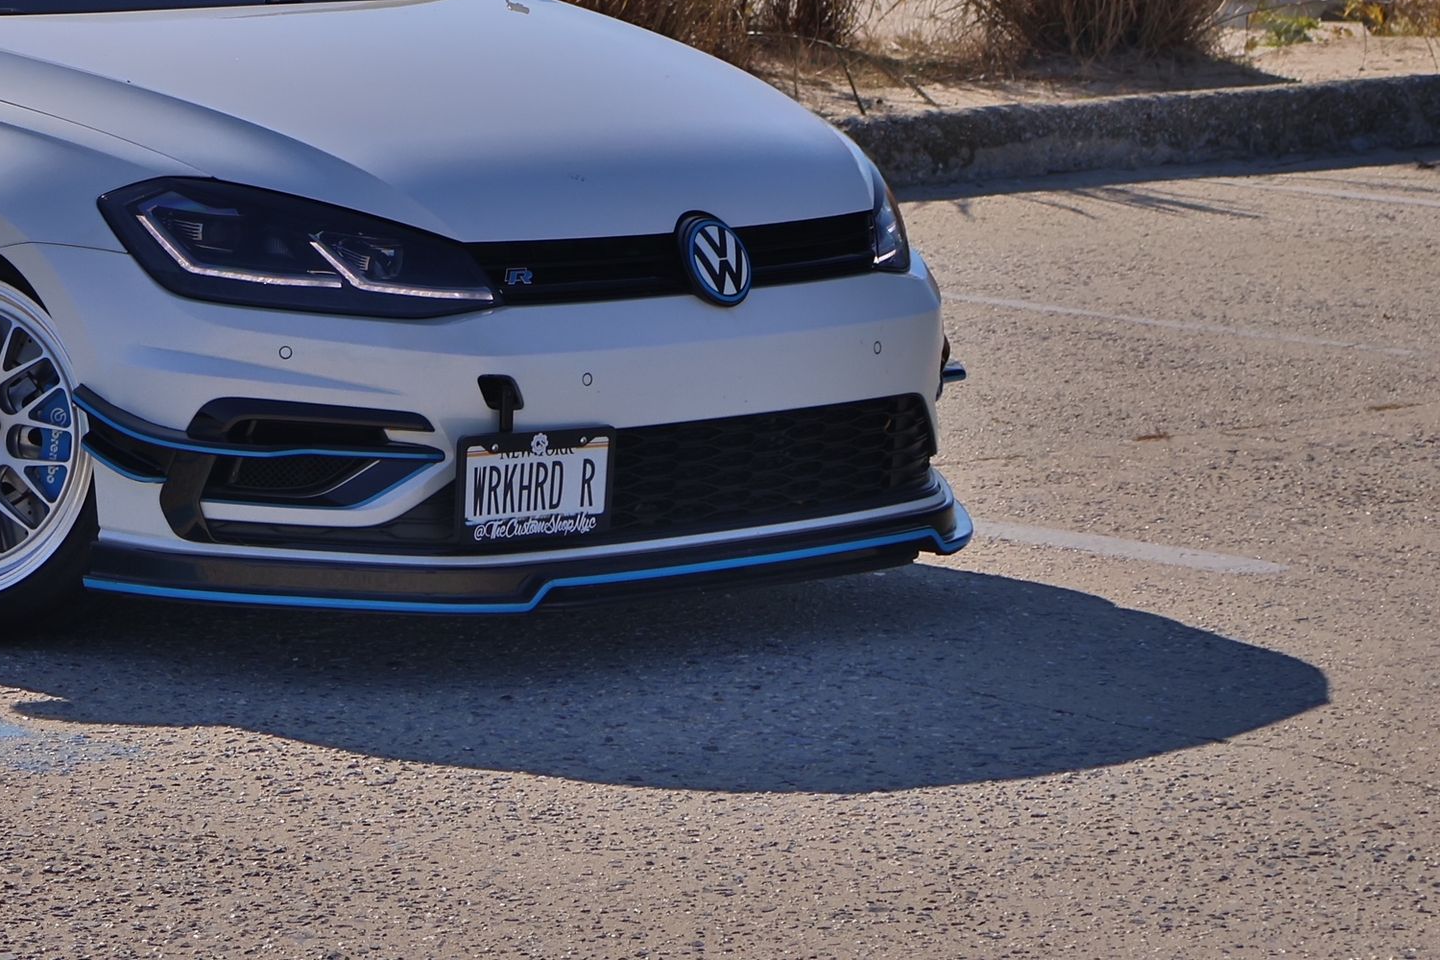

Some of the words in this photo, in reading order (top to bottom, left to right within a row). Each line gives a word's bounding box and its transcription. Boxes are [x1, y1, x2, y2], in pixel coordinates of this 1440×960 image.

[505, 268, 533, 284] R
[473, 460, 564, 516] WRKHRD
[580, 458, 596, 508] R
